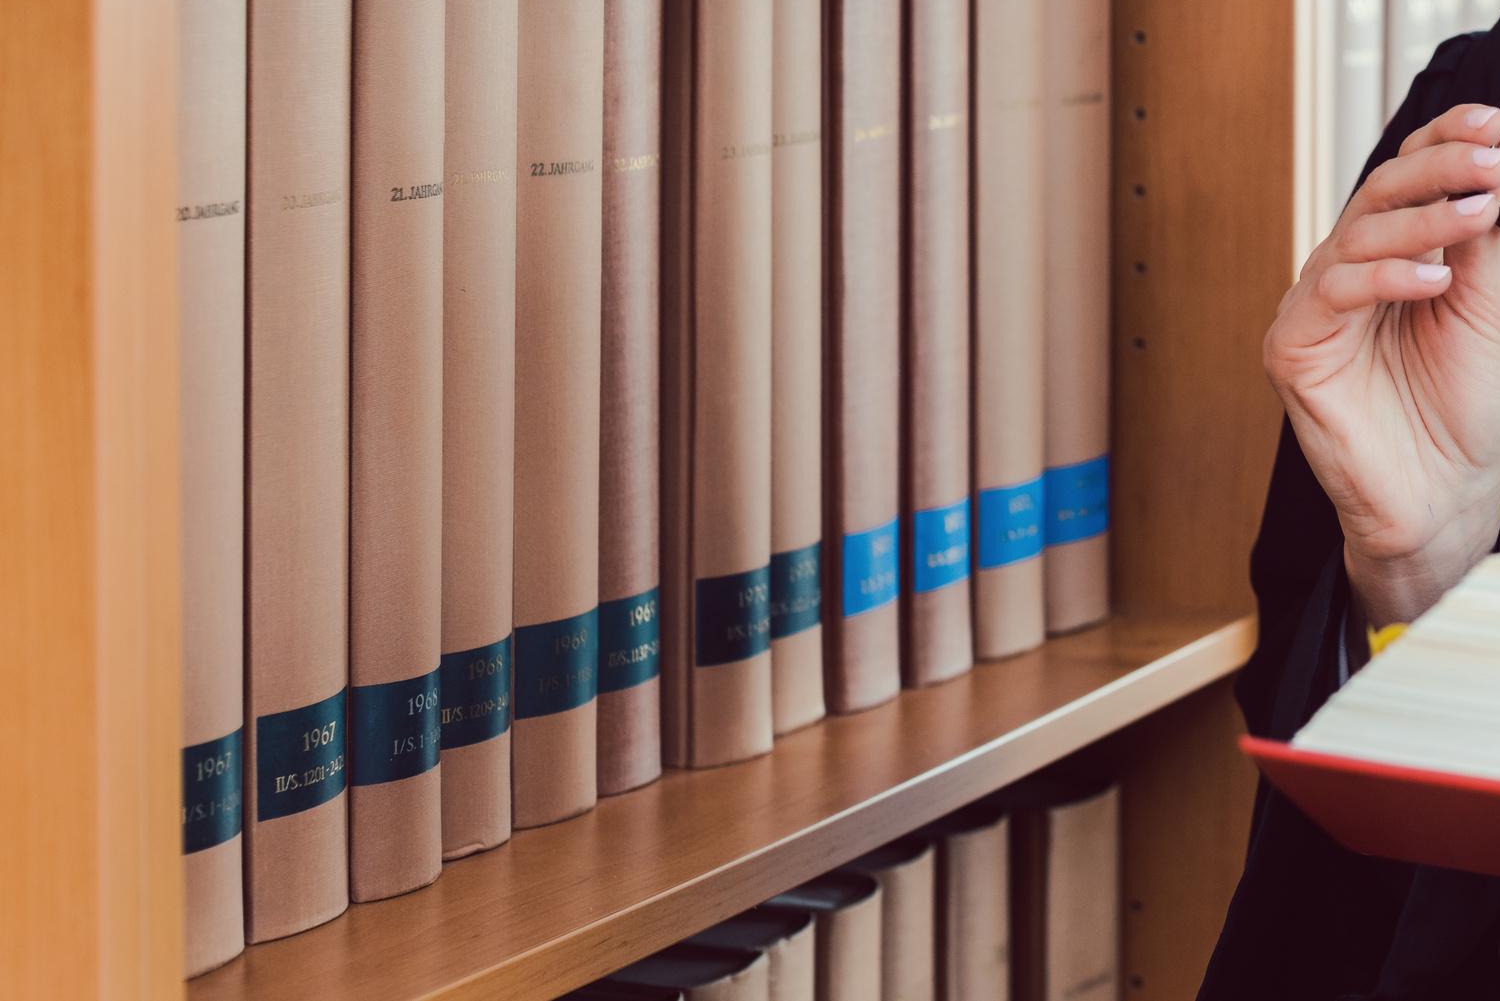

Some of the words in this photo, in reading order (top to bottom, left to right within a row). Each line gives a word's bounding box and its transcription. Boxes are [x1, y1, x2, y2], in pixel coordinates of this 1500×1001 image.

[530, 163, 548, 177] 22.
[391, 186, 408, 202] 21.
[467, 655, 504, 680] 1968
[408, 687, 438, 716] 1968
[303, 720, 337, 752] 1967
[196, 752, 232, 782] 1967
[275, 773, 303, 794] II/S.
